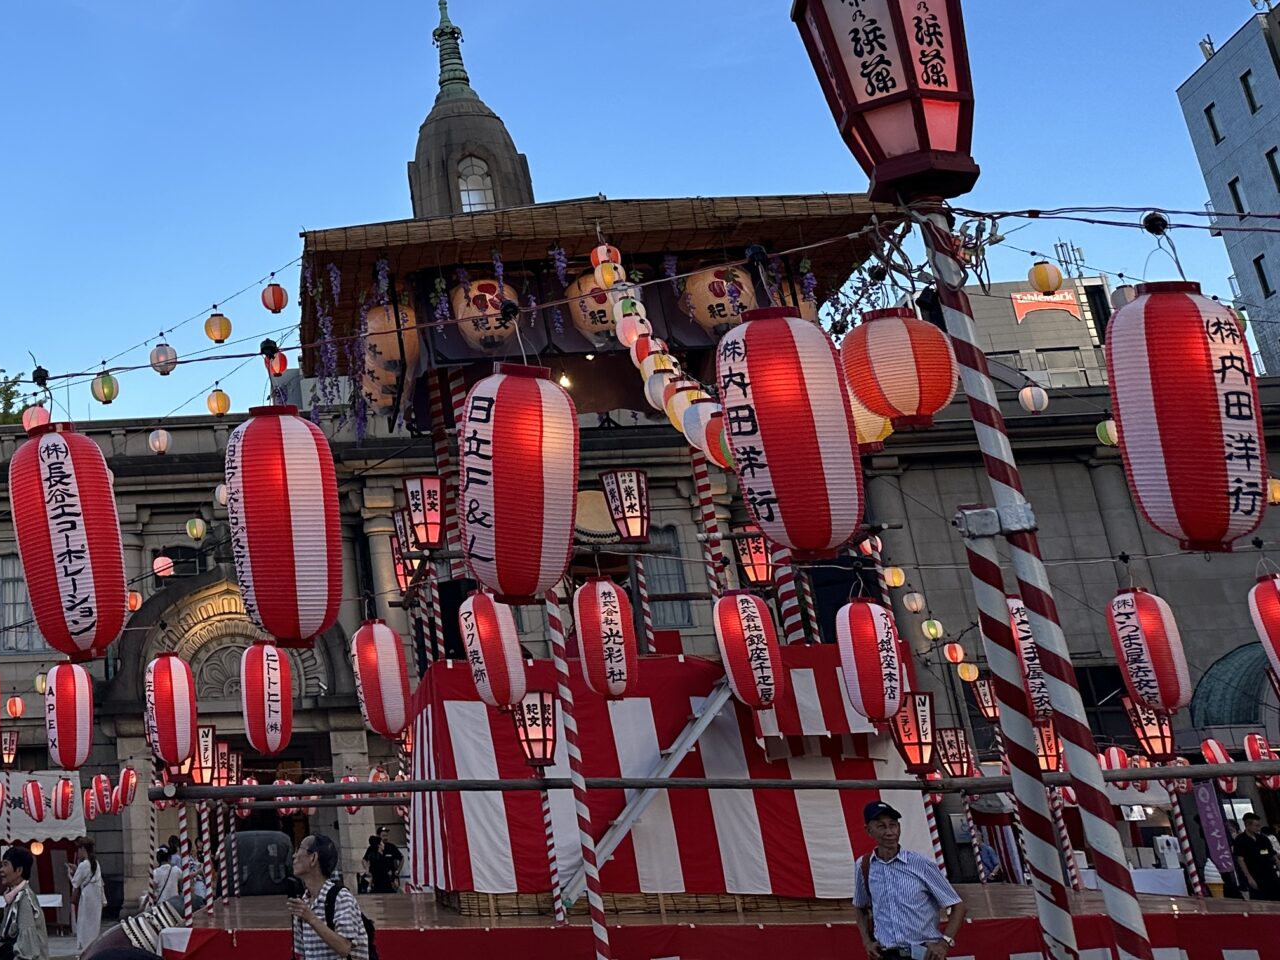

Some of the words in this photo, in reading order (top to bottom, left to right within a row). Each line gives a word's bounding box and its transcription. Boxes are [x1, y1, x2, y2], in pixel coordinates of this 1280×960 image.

[720, 339, 778, 522] 株)内田洋行
[1205, 316, 1263, 516] (株)内田洋行
[410, 490, 423, 513] 紀文
[426, 489, 439, 513] 紀文
[623, 485, 638, 513] 紫水
[459, 610, 486, 684] マック装飾
[600, 590, 627, 684] 株式会社光彩社
[739, 597, 775, 704] 株式会社銀座千疋屋
[877, 612, 898, 700] マルカ銀座本店
[265, 652, 281, 734] ヒトトヒト(株)
[526, 703, 540, 727] 紀文
[47, 686, 57, 749] APEX
[900, 710, 911, 741] ニチレイ
[920, 710, 928, 740] ニチレイ
[202, 740, 210, 765] ニチレイ
[219, 752, 227, 769] 紀文
